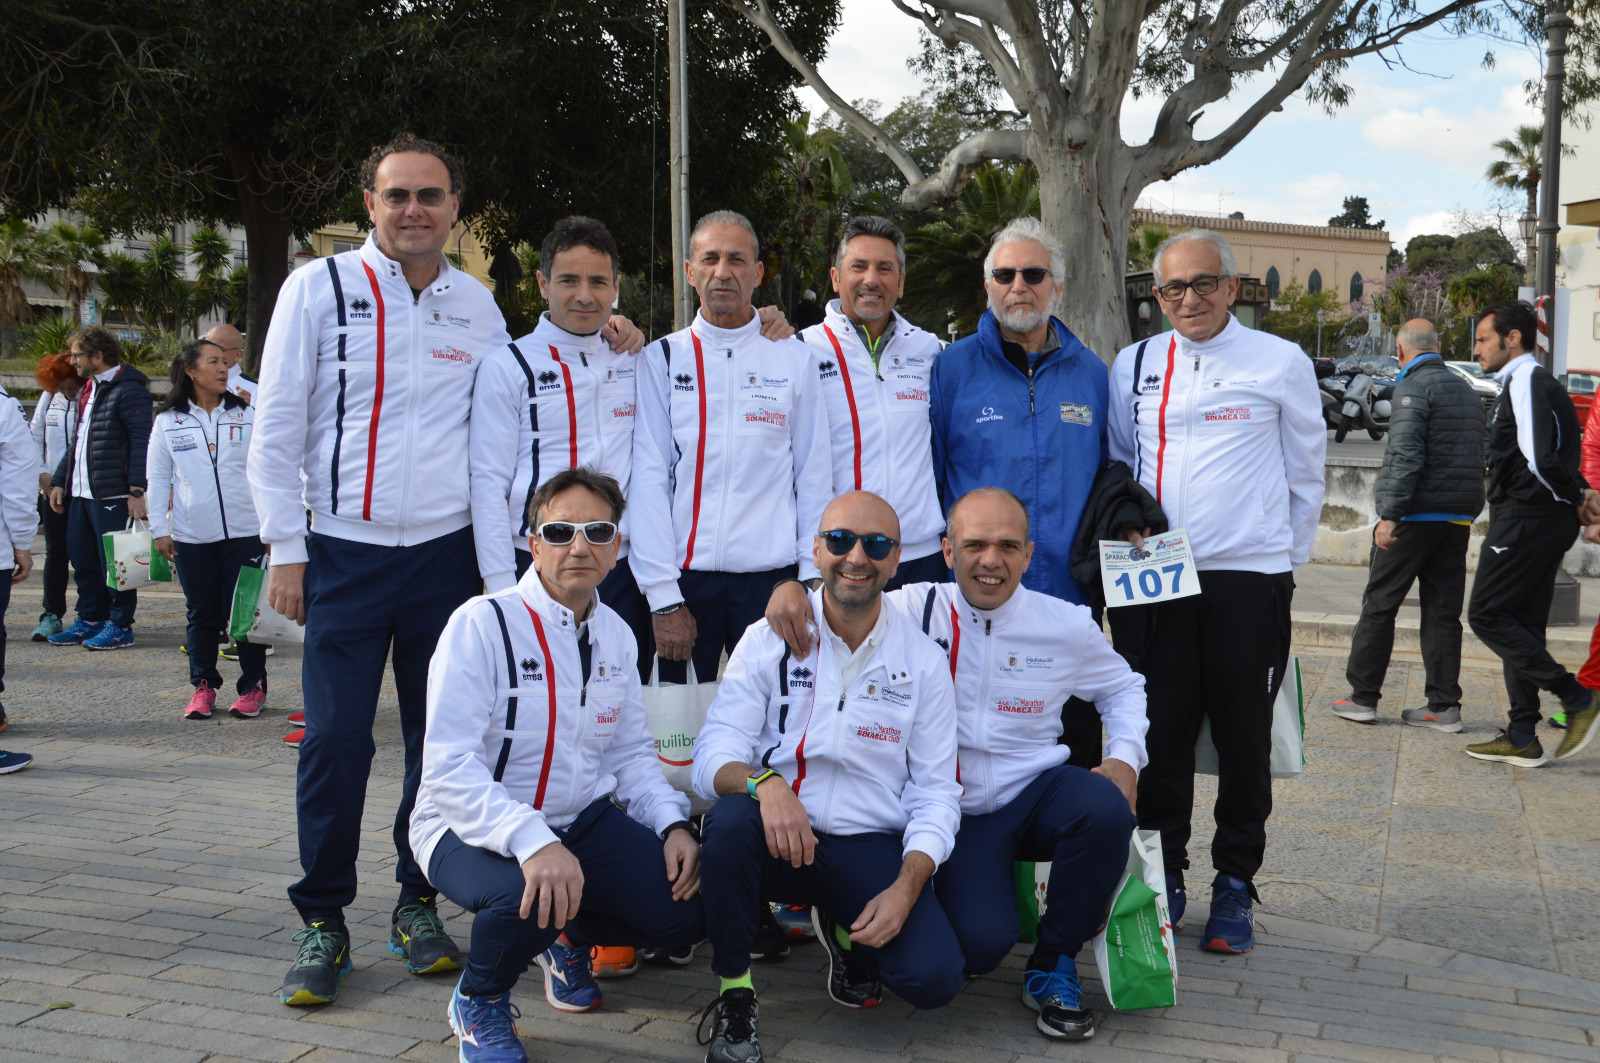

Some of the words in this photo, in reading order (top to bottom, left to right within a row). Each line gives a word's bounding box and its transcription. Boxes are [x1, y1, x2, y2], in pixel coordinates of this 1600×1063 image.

[975, 414, 1003, 424] sportika
[1115, 562, 1185, 601] 107
[522, 673, 543, 681] errea
[790, 680, 813, 688] errea
